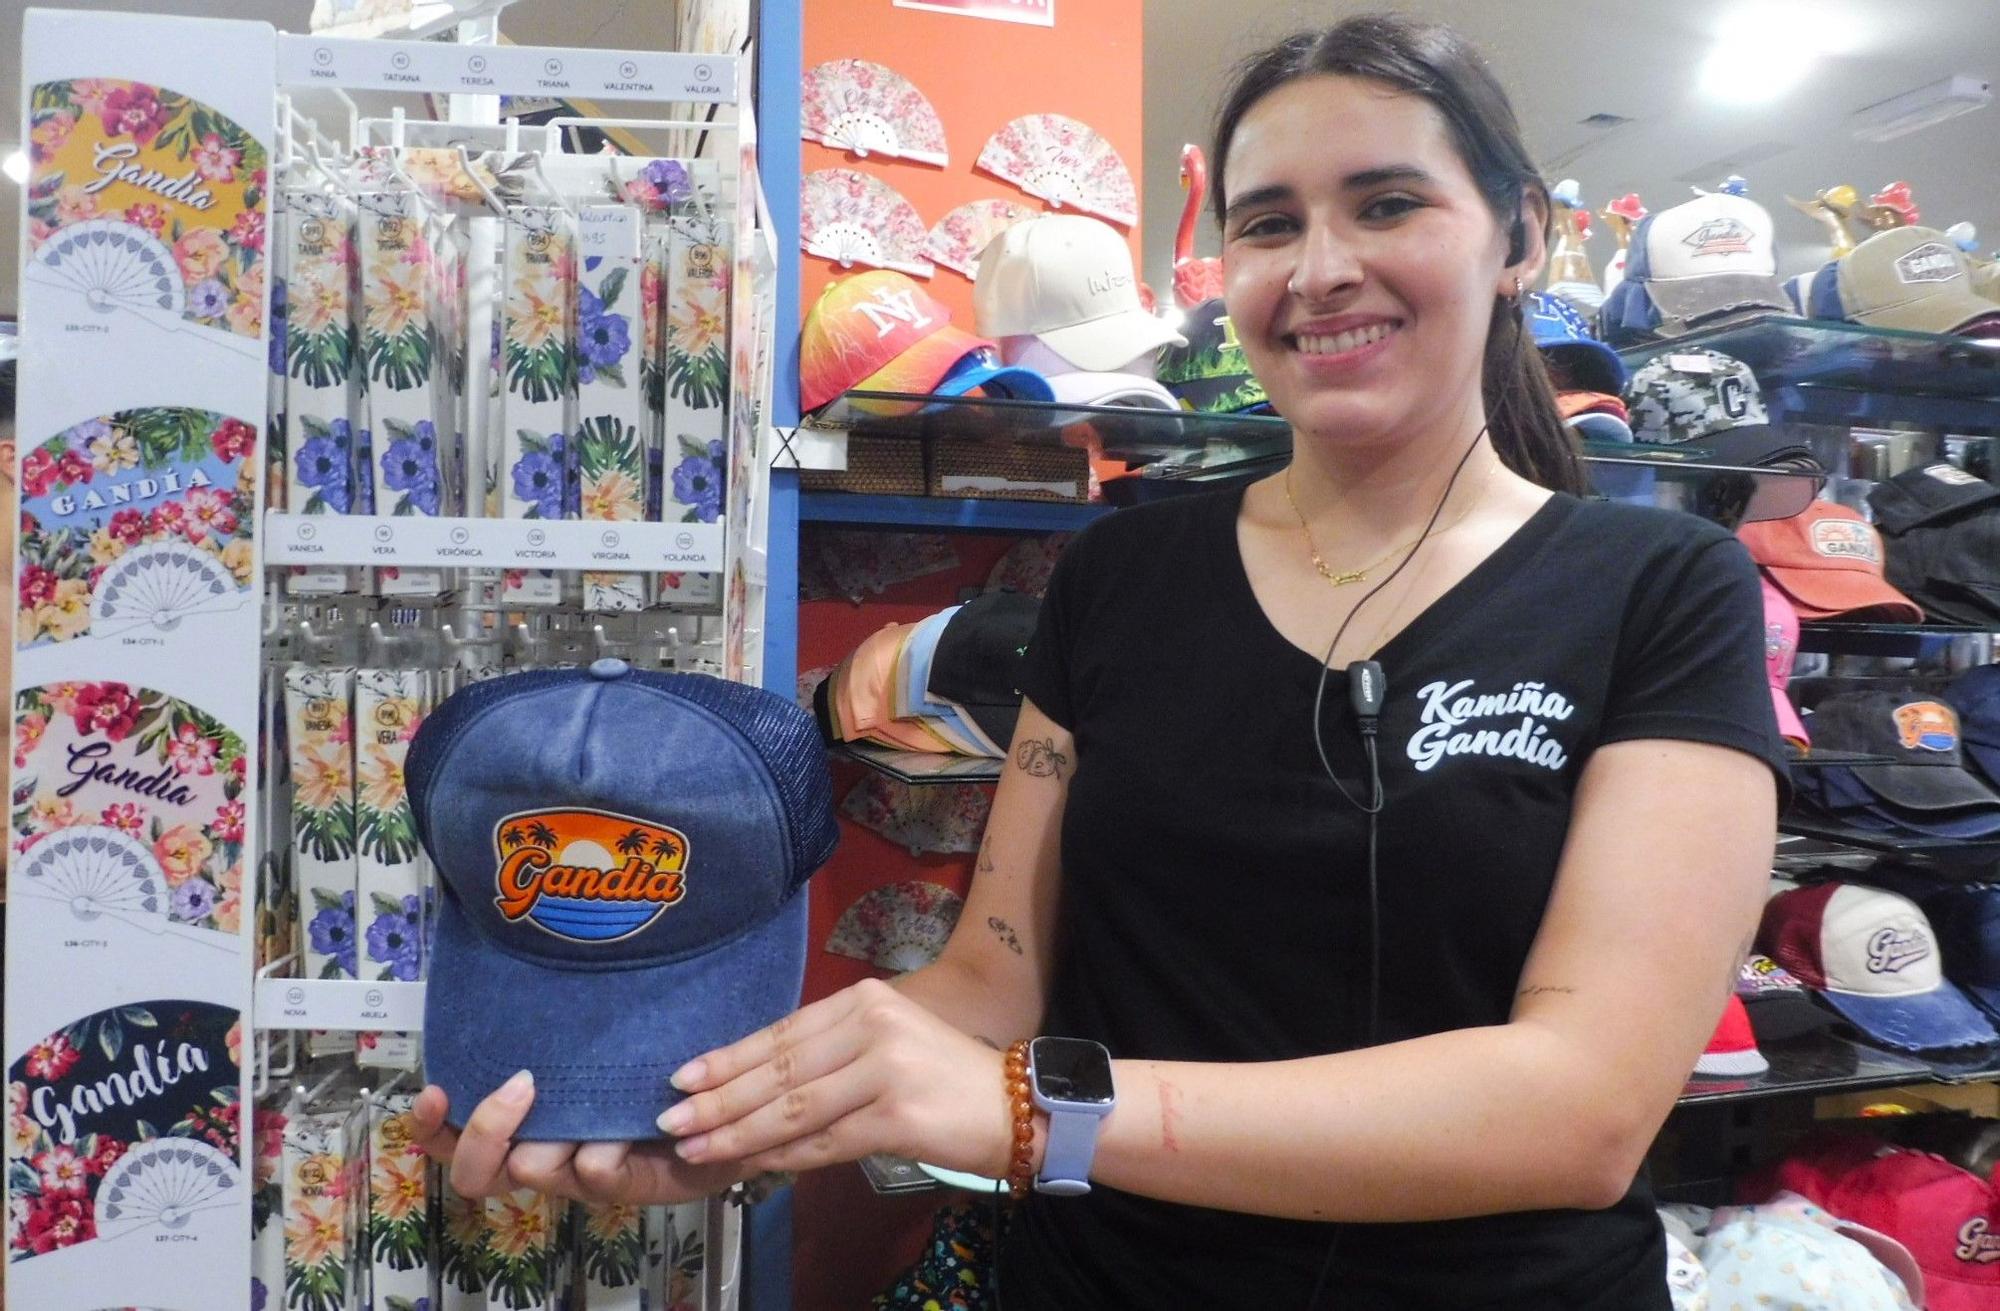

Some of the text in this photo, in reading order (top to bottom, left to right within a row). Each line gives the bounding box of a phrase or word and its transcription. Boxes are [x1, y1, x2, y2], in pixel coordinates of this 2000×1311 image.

[310, 69, 337, 79] TANIA
[382, 72, 420, 83] TATIANA
[461, 76, 494, 86] TERESA
[537, 79, 570, 89] TRIANA
[604, 82, 654, 92] VALENTINA
[684, 85, 721, 95] VALERIA
[1719, 376, 1747, 420] C
[50, 466, 212, 516] GANDÍA
[287, 544, 324, 553] VANESA
[372, 546, 397, 555] VERA
[437, 546, 484, 557] VERÓNICA
[515, 550, 557, 559] VICTORIA
[592, 552, 630, 561] VIRGINIA
[663, 553, 706, 563] YOLANDA
[1416, 679, 1574, 726] Kamiña
[376, 730, 397, 744] VERA
[1406, 717, 1567, 771] Gandía
[57, 741, 198, 806] Gandía
[498, 847, 685, 920] Gandia
[284, 1009, 307, 1017] NOVIA
[32, 1039, 208, 1144] Gandía
